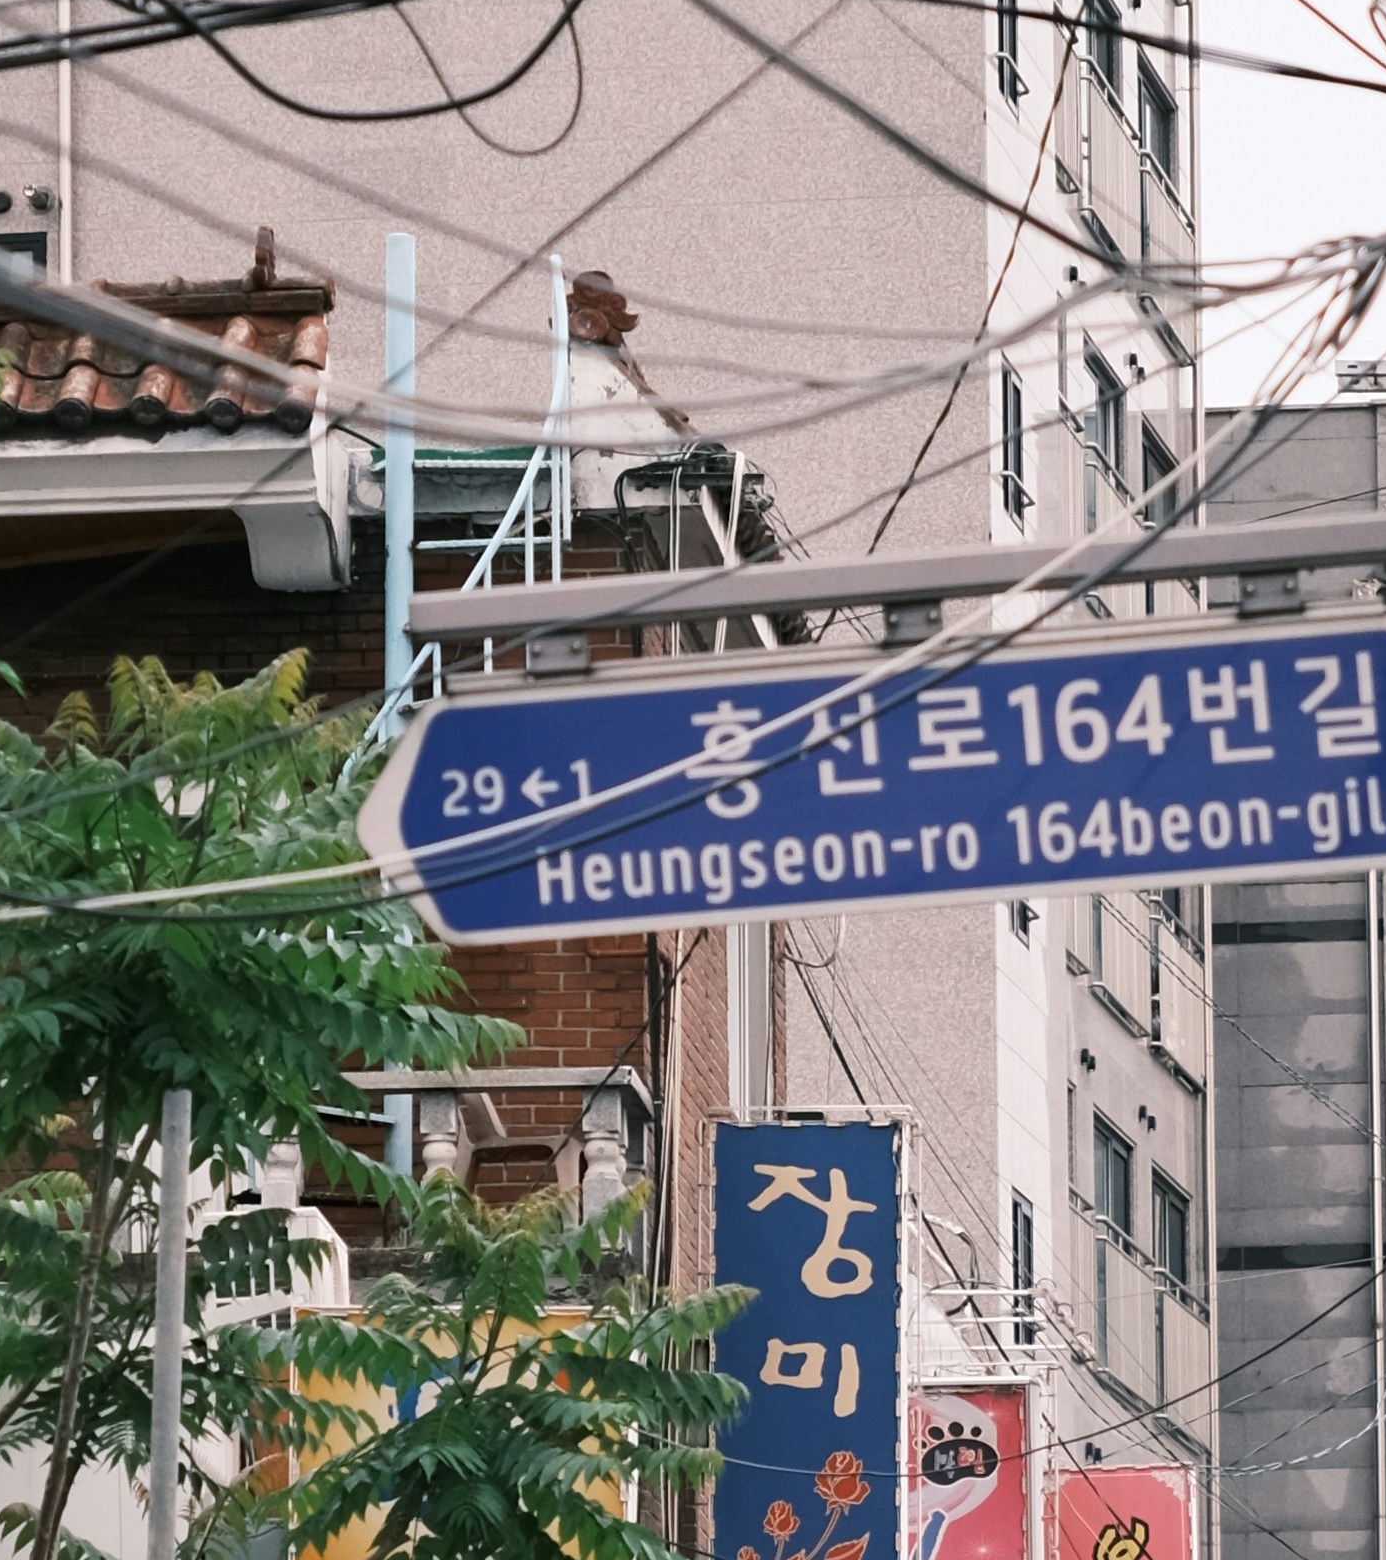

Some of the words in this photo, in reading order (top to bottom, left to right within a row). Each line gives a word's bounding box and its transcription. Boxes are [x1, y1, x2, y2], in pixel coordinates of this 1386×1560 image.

[442, 766, 506, 817] 29
[570, 758, 594, 805] 1
[537, 823, 980, 906] Heungseon-ro
[747, 1162, 877, 1419] 장미
